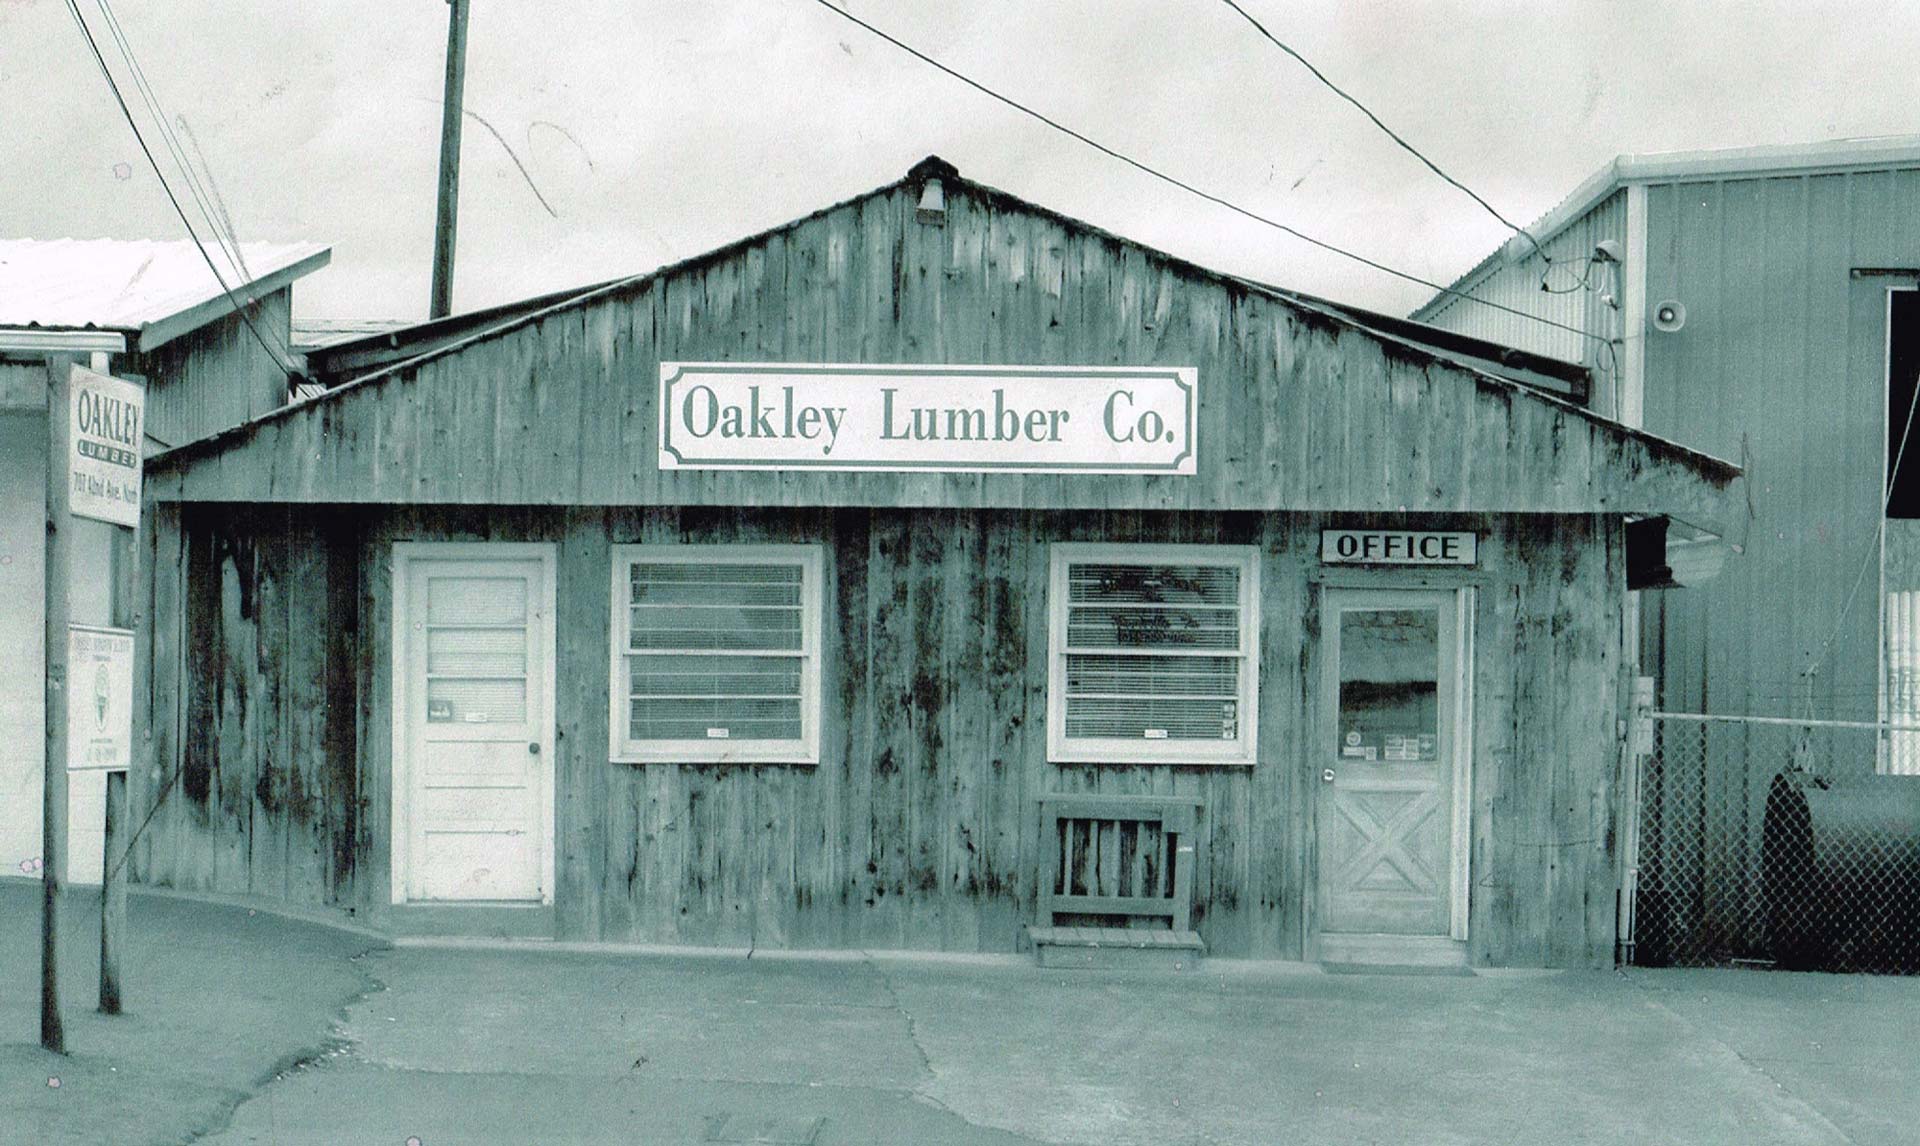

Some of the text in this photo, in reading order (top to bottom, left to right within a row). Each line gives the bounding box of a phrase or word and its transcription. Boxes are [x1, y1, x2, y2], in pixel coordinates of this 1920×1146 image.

[78, 389, 140, 446] OAKLEY
[681, 384, 1175, 455] Oakley Lumber Co.
[79, 441, 136, 466] LUMBER
[1336, 534, 1460, 560] OFFICE
